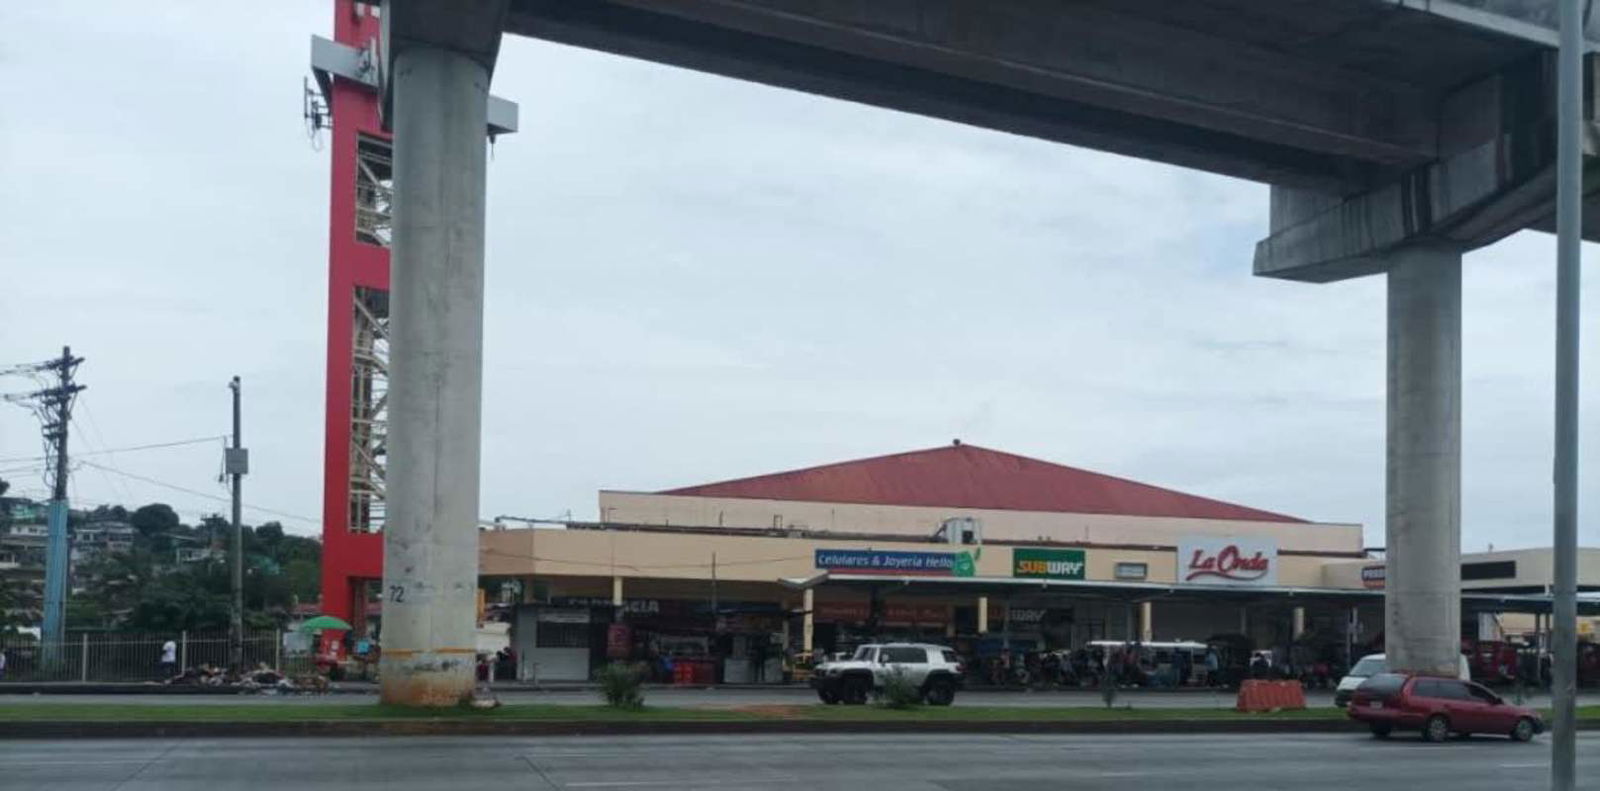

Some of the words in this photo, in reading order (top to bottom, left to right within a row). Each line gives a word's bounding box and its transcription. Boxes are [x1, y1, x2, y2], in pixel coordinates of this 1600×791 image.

[817, 554, 869, 567] Celulares
[871, 556, 881, 566] &
[1189, 550, 1216, 569] La
[1217, 545, 1269, 573] Onda
[1017, 560, 1083, 575] SUBWAY
[389, 585, 404, 603] 72
